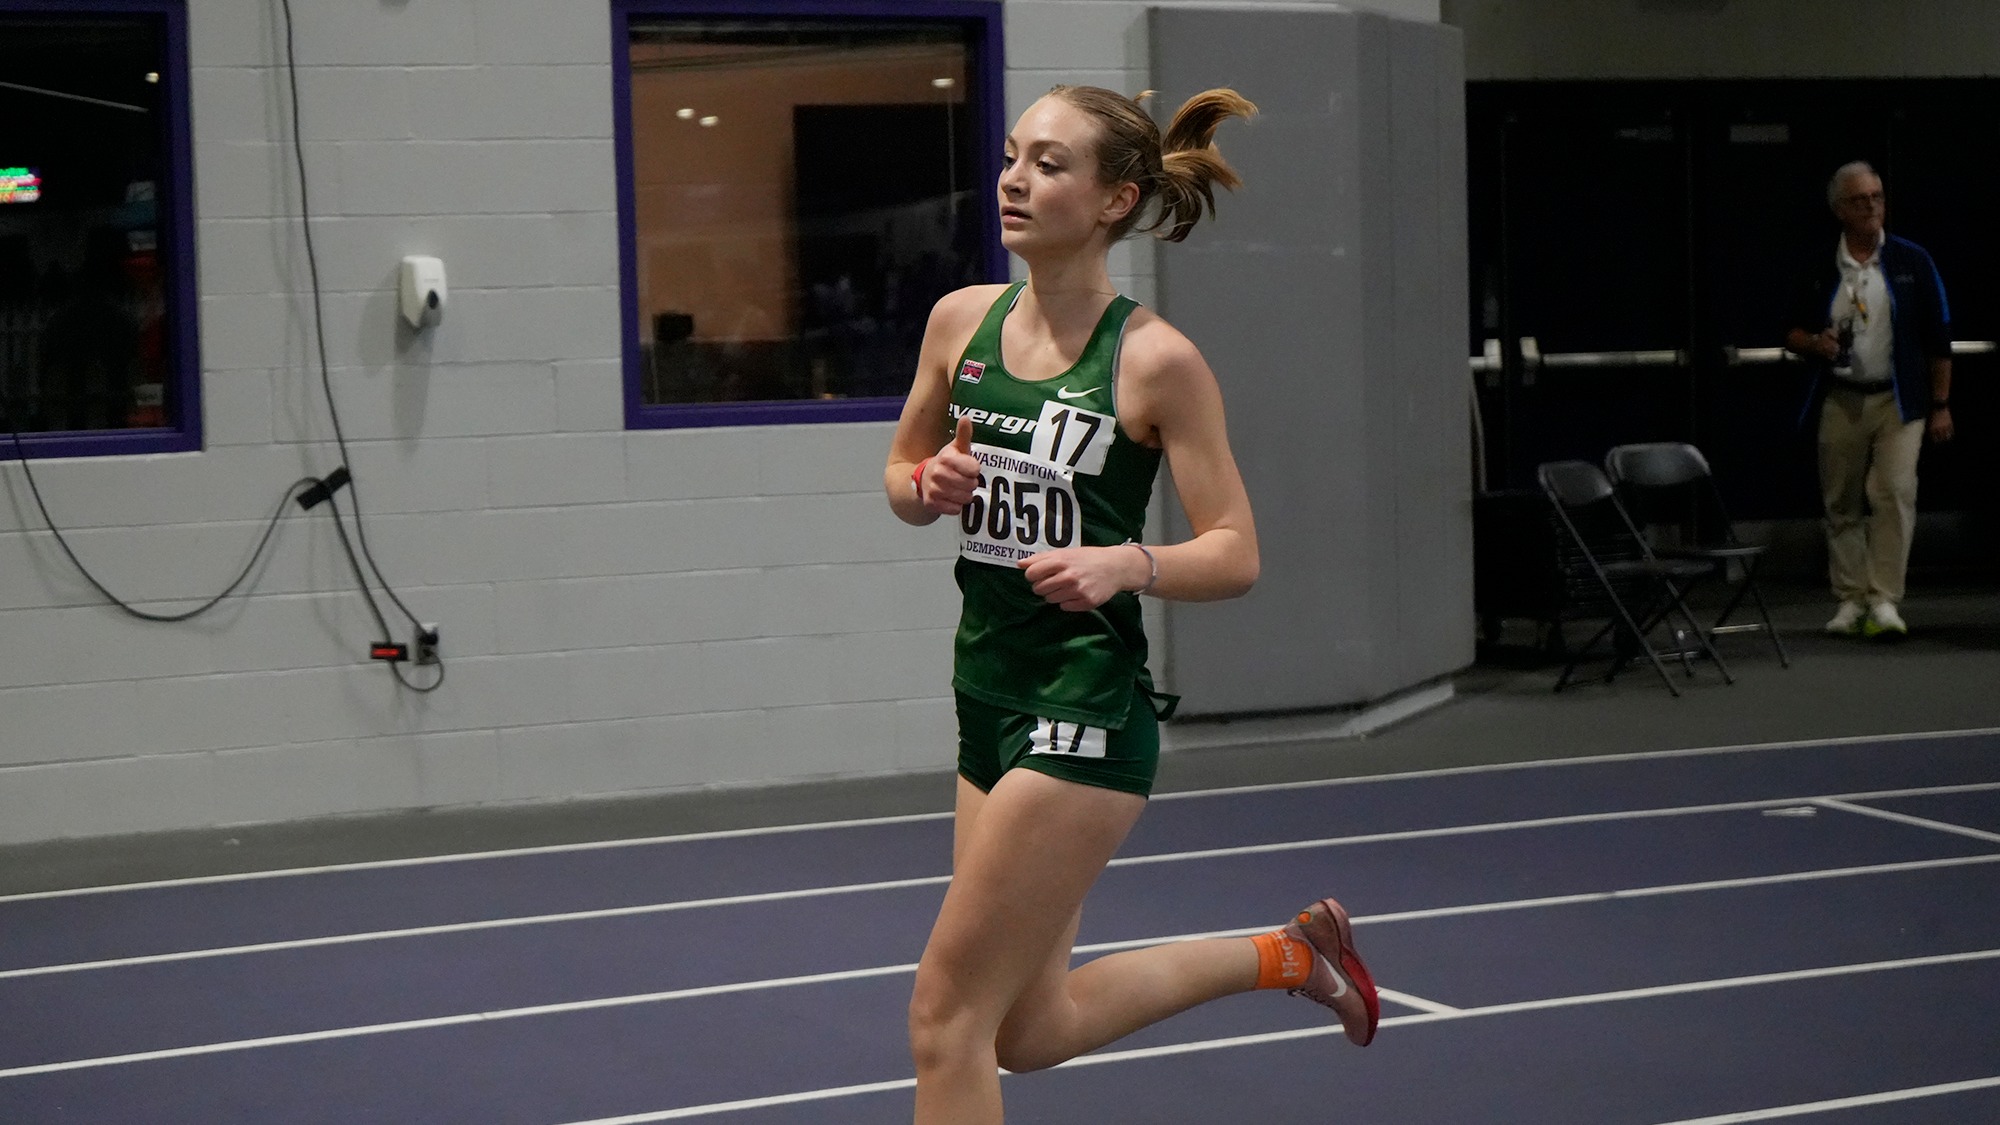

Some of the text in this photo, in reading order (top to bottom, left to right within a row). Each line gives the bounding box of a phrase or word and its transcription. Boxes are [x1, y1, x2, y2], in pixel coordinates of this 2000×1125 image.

[1049, 408, 1102, 468] 17
[970, 451, 1057, 481] WASHINGTON
[961, 472, 1073, 548] 6650
[966, 540, 1015, 559] DEMPSEY
